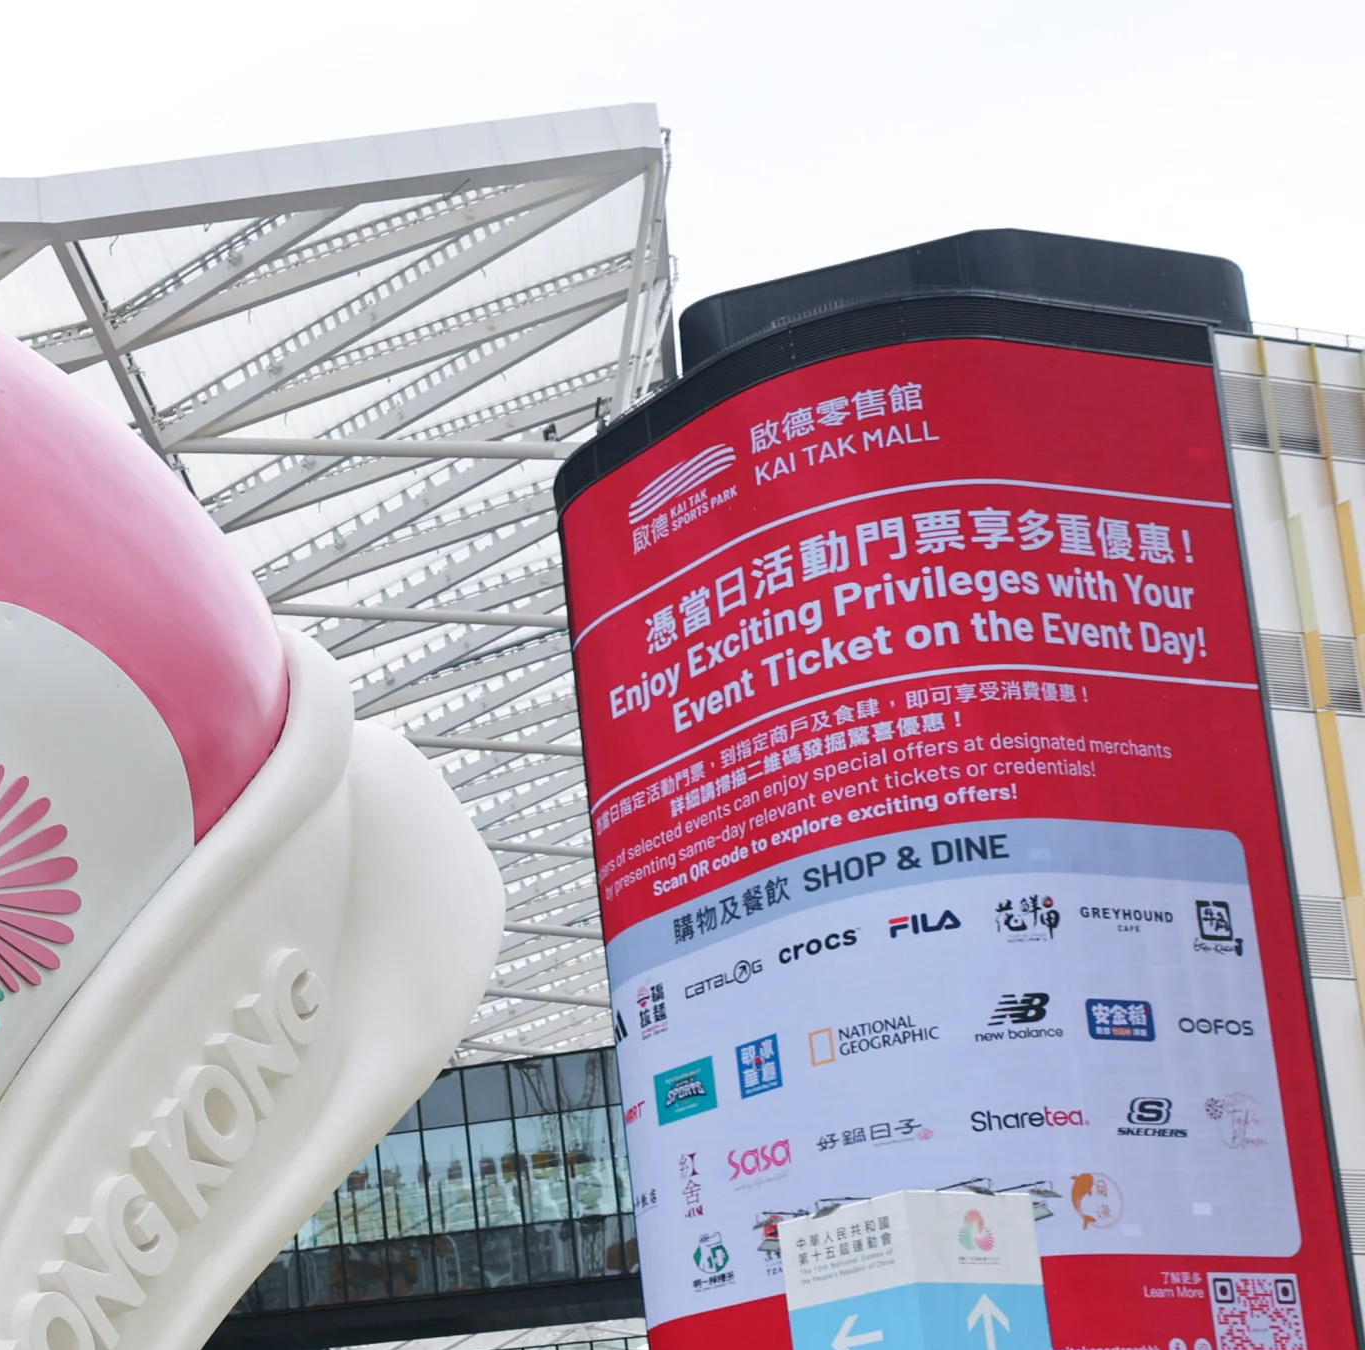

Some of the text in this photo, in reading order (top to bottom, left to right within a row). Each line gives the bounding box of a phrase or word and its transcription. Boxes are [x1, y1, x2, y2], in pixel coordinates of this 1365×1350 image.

[750, 382, 924, 454] 啟德零售館
[754, 421, 940, 486] KAI TAK MALL
[670, 488, 708, 519] KAI TAK
[671, 485, 738, 532] SPORTS PARK
[609, 565, 1194, 720] Enjoy Exciting Privileges with Your
[672, 610, 1207, 733] Event Ticket on the Event Day!
[616, 848, 627, 867] of
[628, 822, 682, 860] selected
[684, 803, 731, 835] events
[733, 790, 760, 812] can
[763, 772, 809, 799] enjoy
[813, 748, 887, 781] special
[893, 739, 958, 762] offers
[964, 735, 984, 751] at
[990, 733, 1086, 753] designated
[1089, 739, 1172, 759] merchants
[614, 852, 677, 897] presenting
[679, 821, 746, 861] same-day
[749, 794, 816, 832] relevant
[821, 776, 879, 805] event
[884, 763, 961, 789] tickets
[966, 762, 987, 777] or
[993, 758, 1096, 778] credentials!
[653, 783, 1018, 897] Scan QR code to explore exciting offers!
[803, 834, 1010, 893] SHOP & DINE
[673, 876, 791, 945] 購物及餐飲
[889, 909, 961, 939] FILA
[1080, 906, 1174, 923] GREYHOUND
[778, 929, 858, 964] crocs
[838, 1015, 916, 1041] NATIONAL
[839, 1026, 940, 1056] GEOGRAPHIC
[974, 1026, 1064, 1043] new balance
[1178, 1017, 1254, 1036] OOFOS
[131, 948, 327, 1222] KONG
[1117, 1127, 1188, 1138] SKECHERS
[795, 1216, 891, 1249] 中華人民共和國
[798, 1231, 893, 1266] 第十五屆運動會
[1143, 1286, 1205, 1299] Learn More
